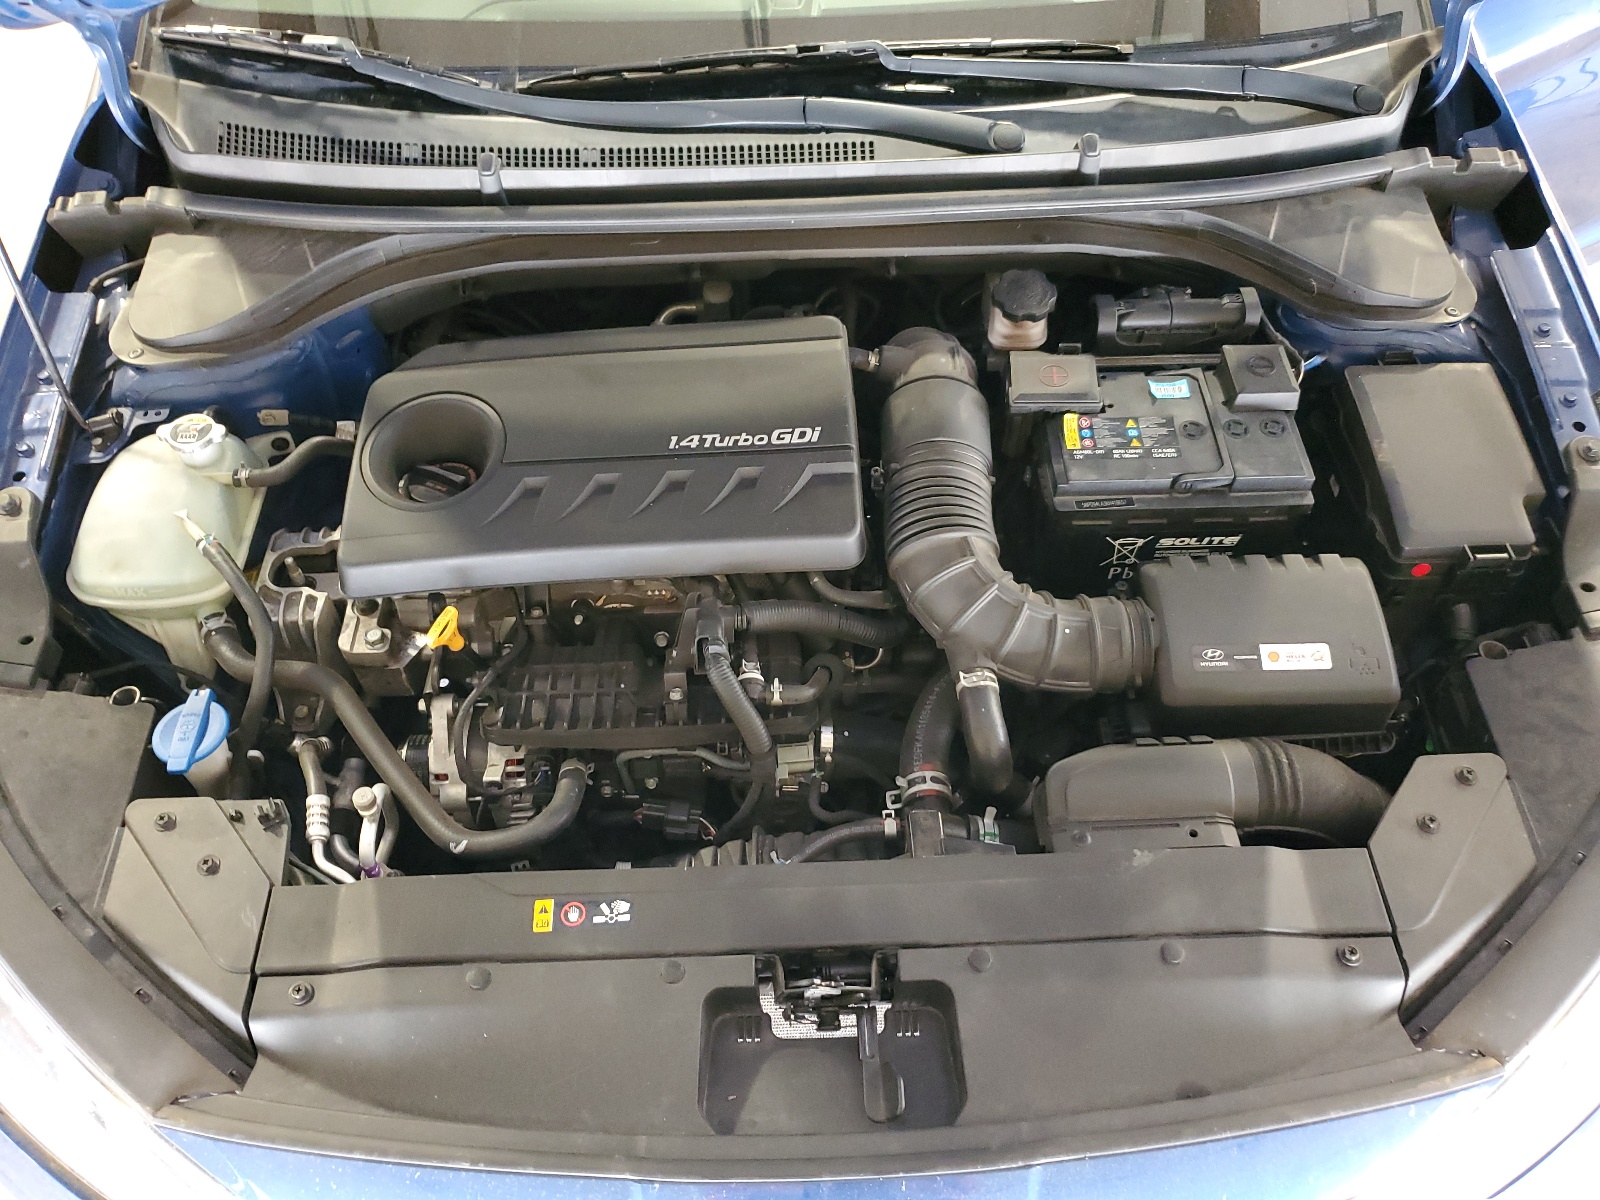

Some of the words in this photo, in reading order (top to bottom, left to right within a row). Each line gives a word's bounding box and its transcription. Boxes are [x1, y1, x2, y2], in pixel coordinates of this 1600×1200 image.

[668, 434, 700, 449] 1.4
[702, 432, 769, 448] Turbo
[770, 426, 822, 445] GDi
[1157, 534, 1243, 547] SOLITE
[1107, 567, 1134, 580] Pb
